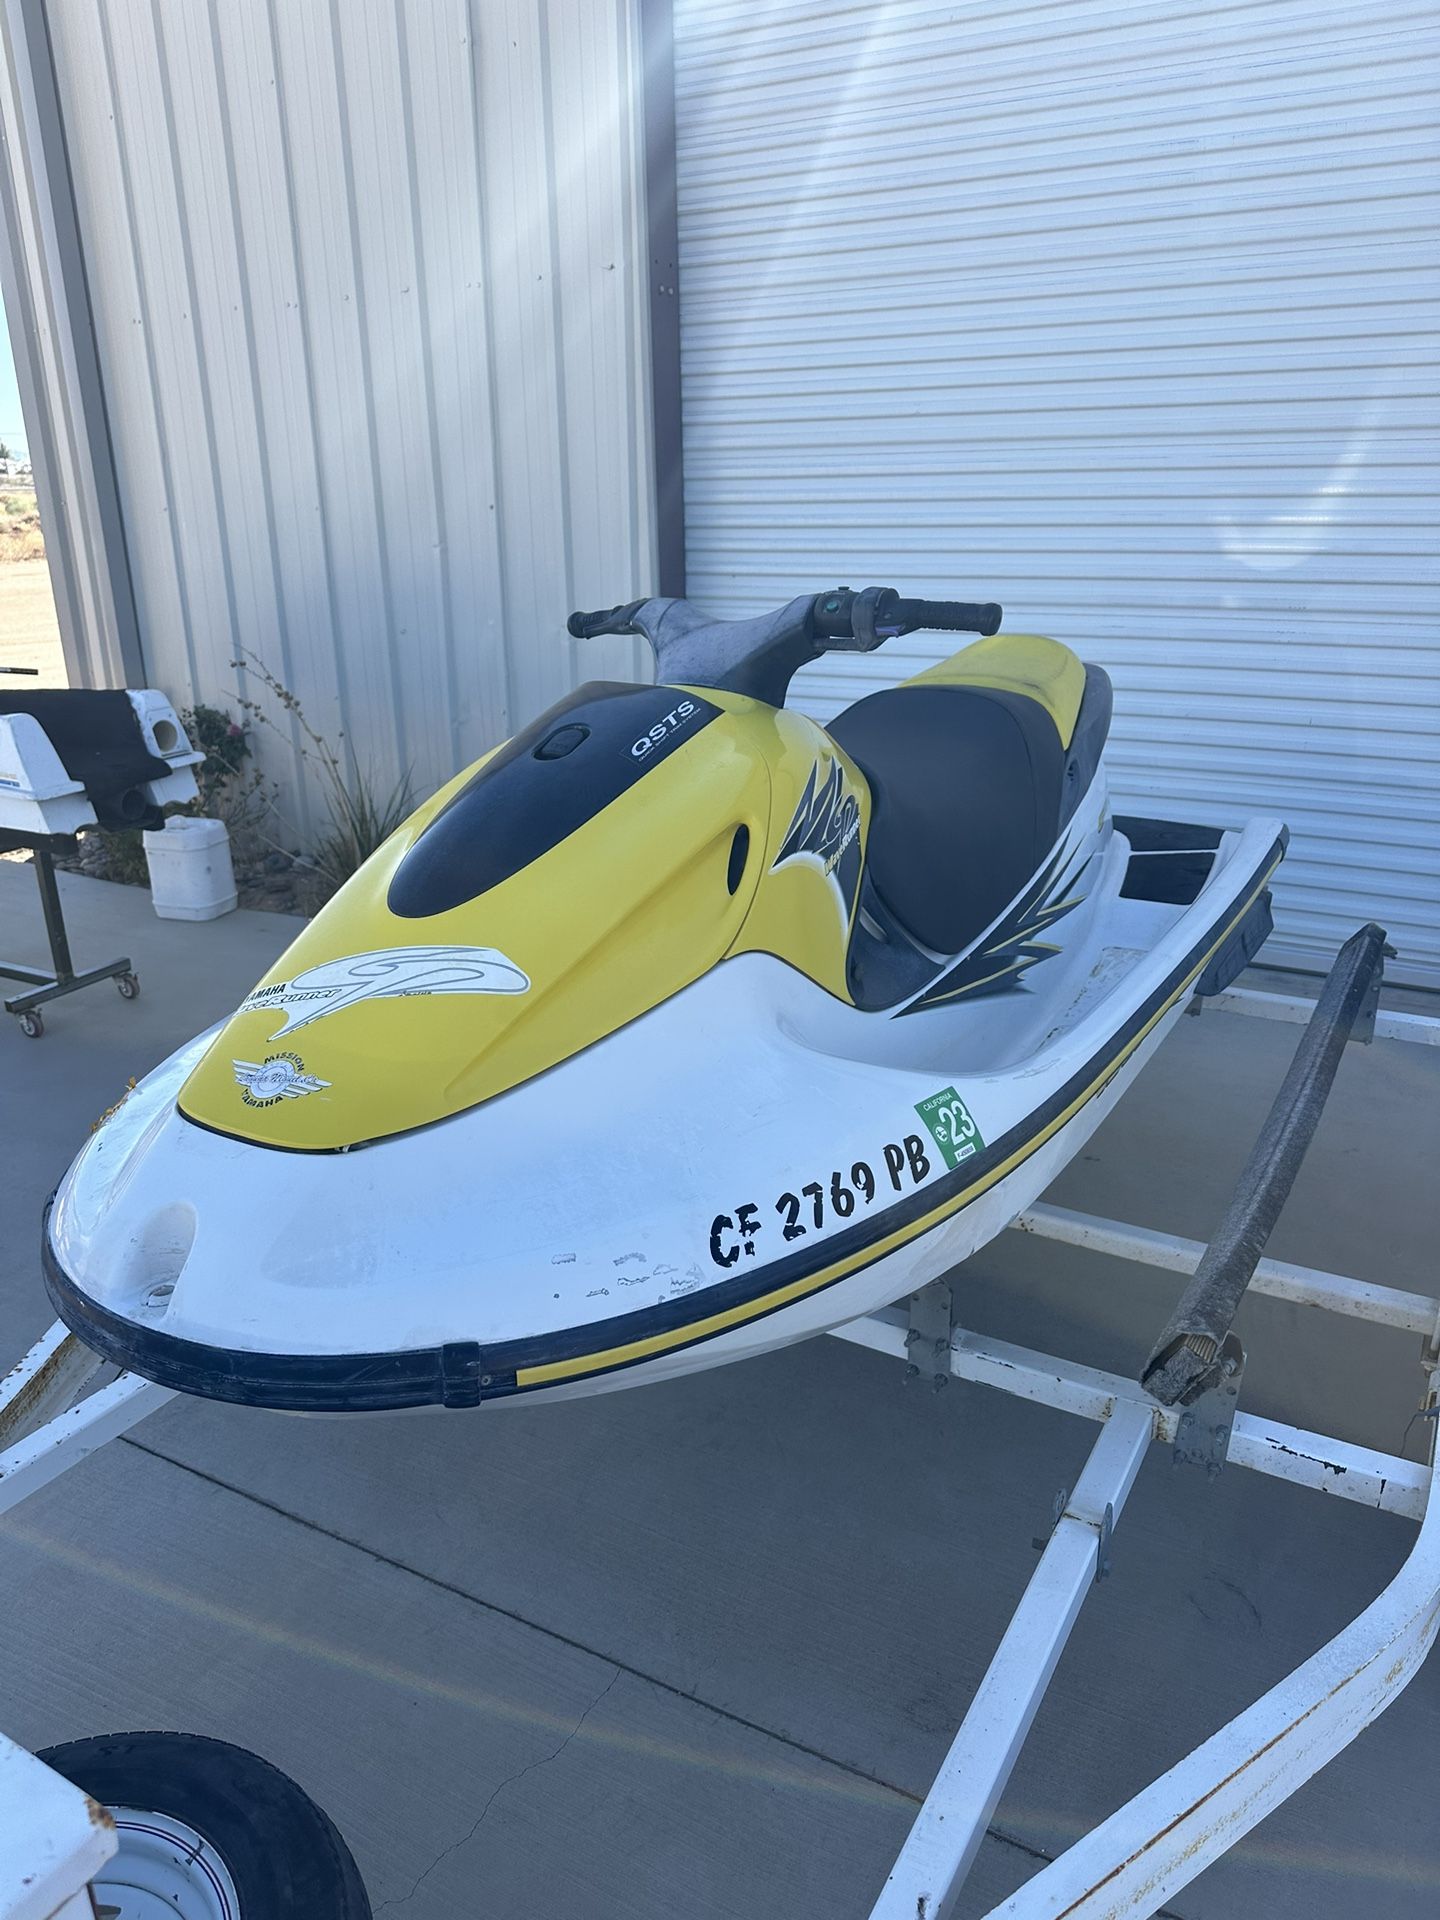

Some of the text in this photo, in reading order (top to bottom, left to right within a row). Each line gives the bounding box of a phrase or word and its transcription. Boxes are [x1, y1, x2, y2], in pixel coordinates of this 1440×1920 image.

[631, 700, 695, 757] QSTS
[264, 1051, 304, 1072] MISSION
[241, 1088, 283, 1108] YAMAHA
[923, 1092, 953, 1112] CALIFORNIA
[938, 1100, 975, 1146] 23
[709, 1134, 931, 1268] CF 2769 PB
